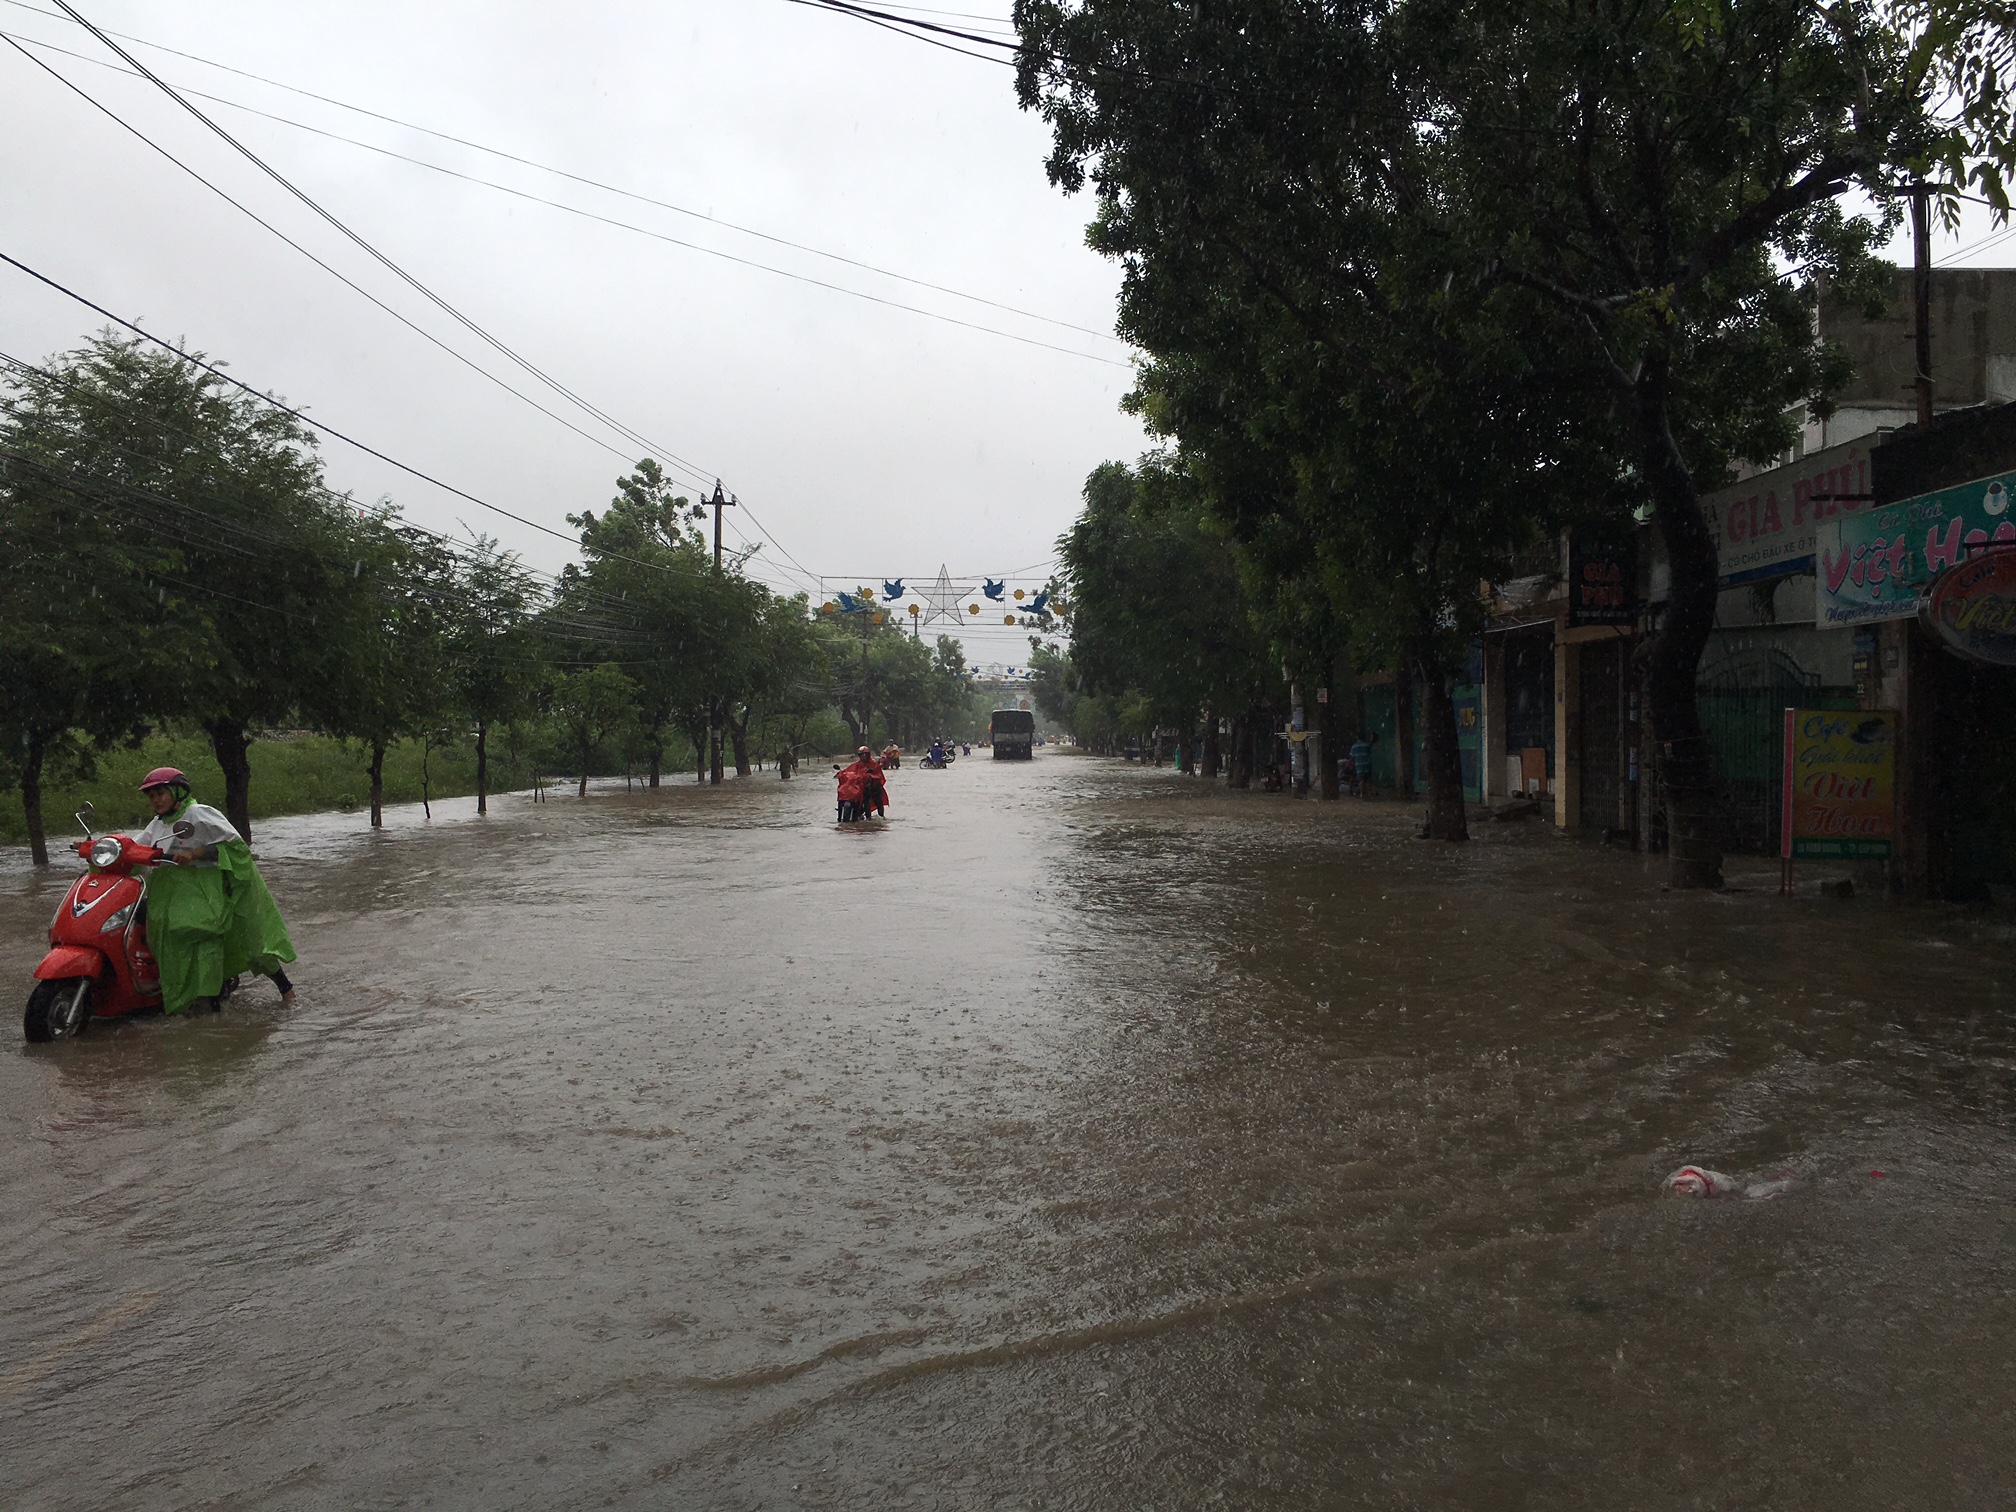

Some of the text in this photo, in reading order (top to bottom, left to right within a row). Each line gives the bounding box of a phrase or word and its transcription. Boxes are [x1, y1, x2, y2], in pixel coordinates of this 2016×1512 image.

[1727, 447, 1866, 544] GIA PHÚ
[1583, 562, 1622, 582] GIA
[1823, 532, 1906, 598] Việt
[1857, 683, 1865, 694] 22
[1808, 804, 1883, 835] Hoa
